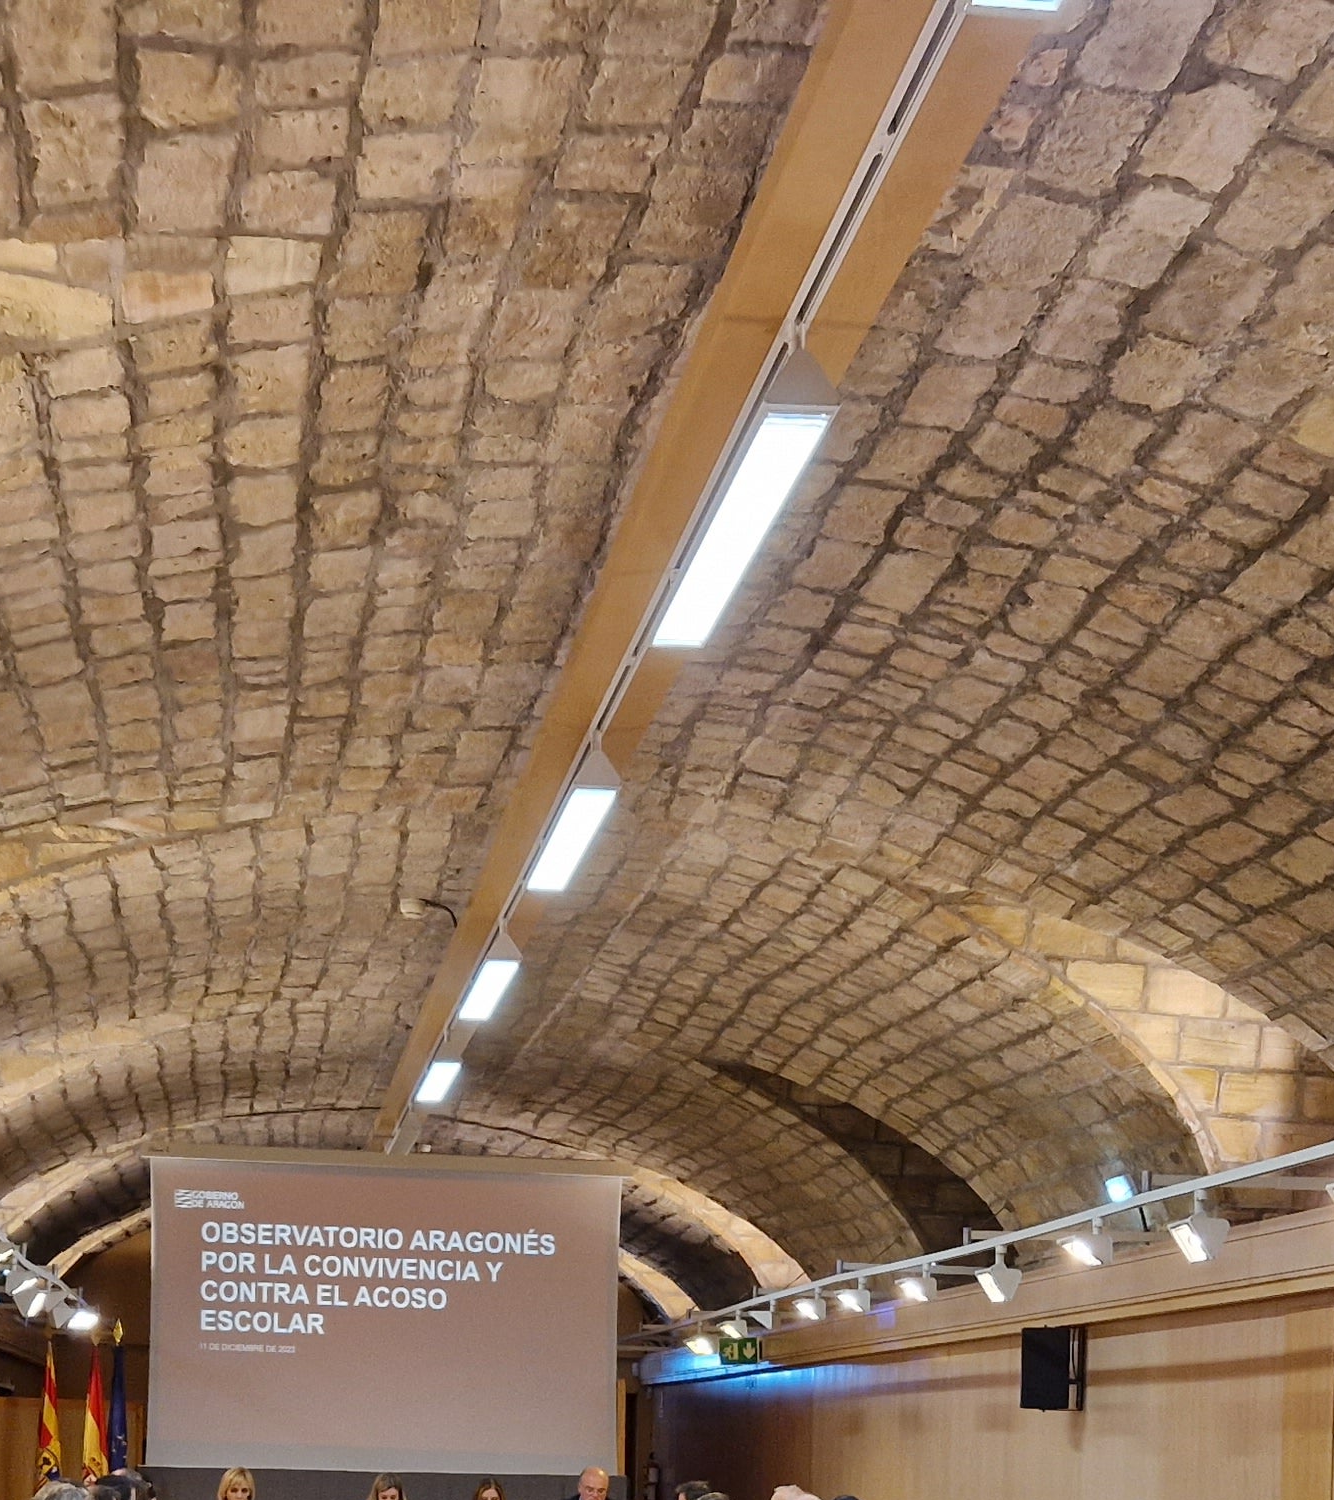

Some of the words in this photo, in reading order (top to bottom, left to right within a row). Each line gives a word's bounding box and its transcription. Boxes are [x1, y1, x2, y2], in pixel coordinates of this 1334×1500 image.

[201, 1221, 404, 1250] OBSERVATORIO
[409, 1228, 556, 1256] ARAGONÉS
[201, 1251, 256, 1274] POR
[264, 1253, 298, 1275] LA
[304, 1254, 481, 1282] CONVIVENCIA
[486, 1261, 504, 1282] Y
[200, 1280, 310, 1305] CONTRA
[316, 1284, 349, 1306] EL
[353, 1285, 447, 1310] ACOSO
[200, 1309, 325, 1335] ESCOLAR
[209, 1342, 219, 1351] DE
[221, 1343, 265, 1353] DICIEMBRE
[266, 1344, 276, 1353] DE
